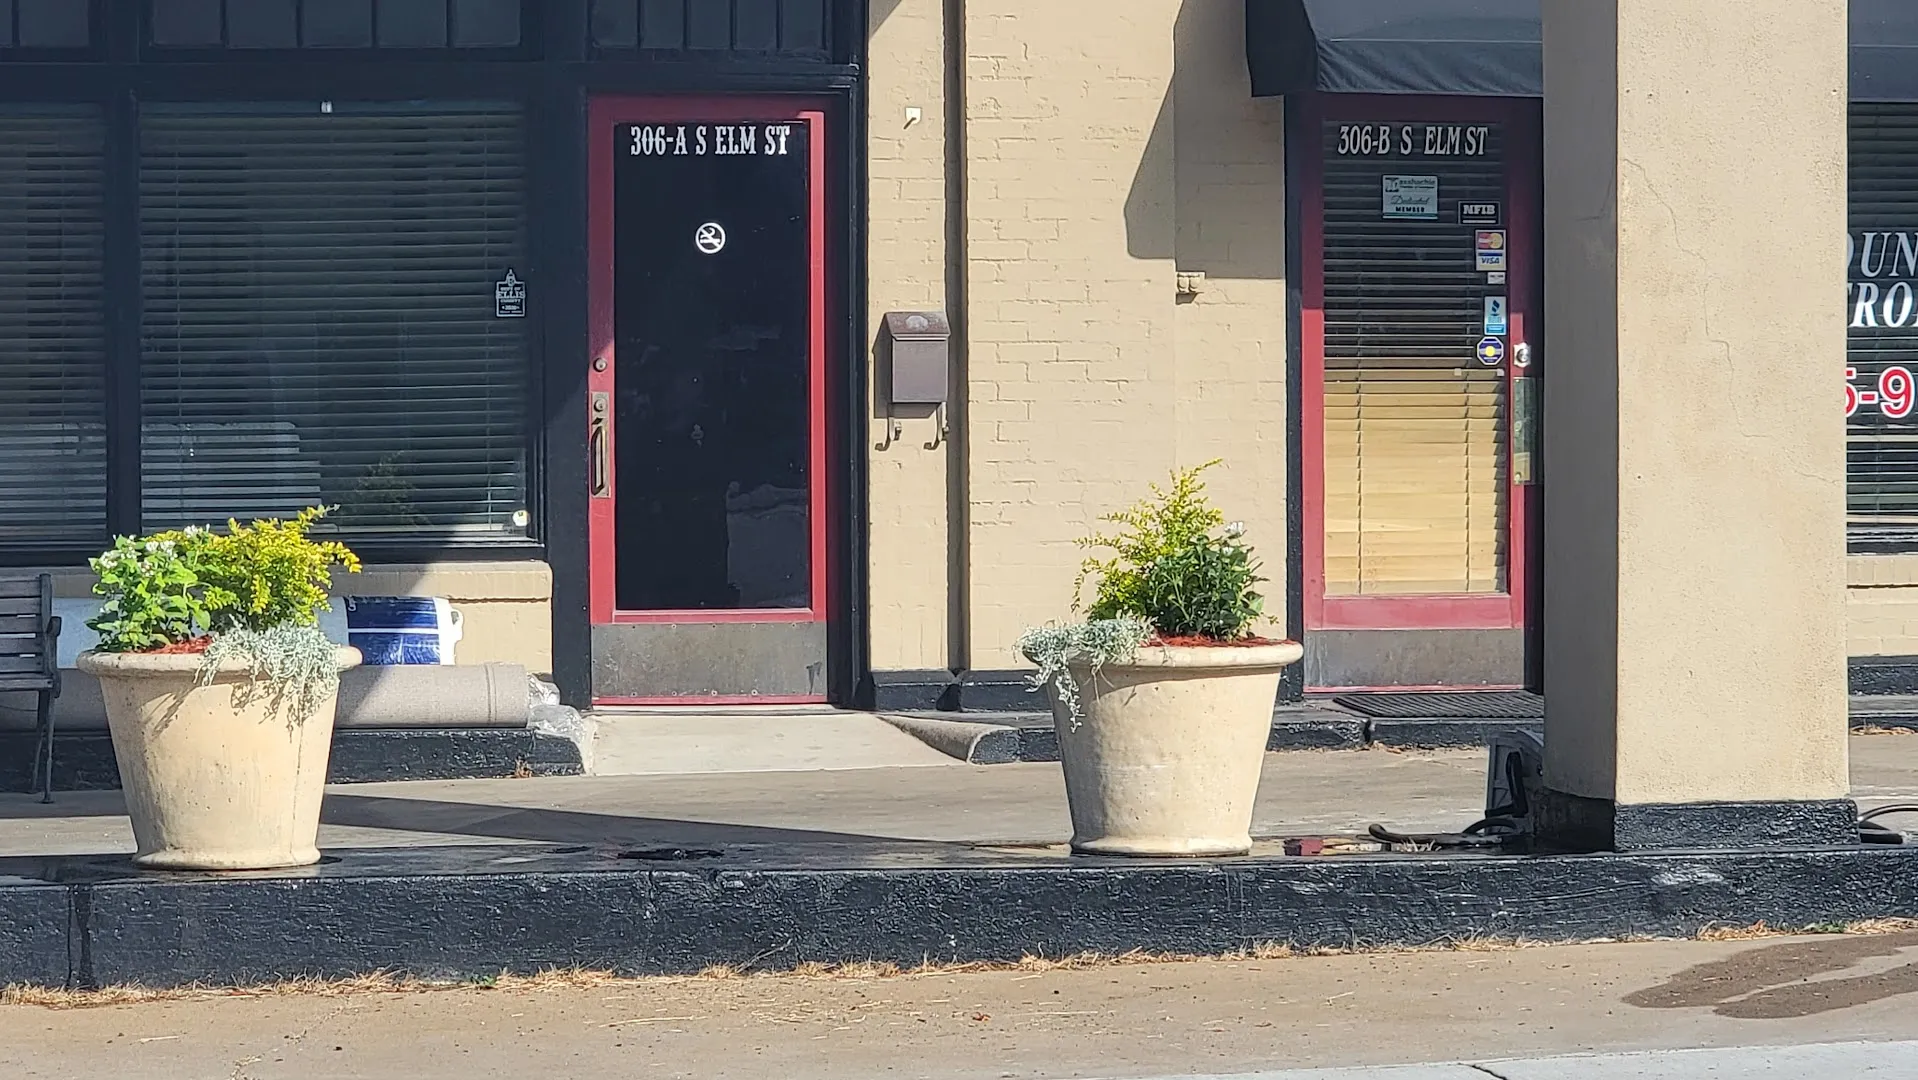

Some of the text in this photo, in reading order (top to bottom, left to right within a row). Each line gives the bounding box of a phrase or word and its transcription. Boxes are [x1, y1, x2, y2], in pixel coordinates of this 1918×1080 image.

[630, 125, 791, 156] 306-A S ELM ST
[1337, 125, 1489, 155] 306-B S ELM ST
[1463, 204, 1496, 215] NFIB
[1481, 257, 1500, 265] VISA
[1847, 232, 1918, 278] UN
[1847, 281, 1918, 328] RO
